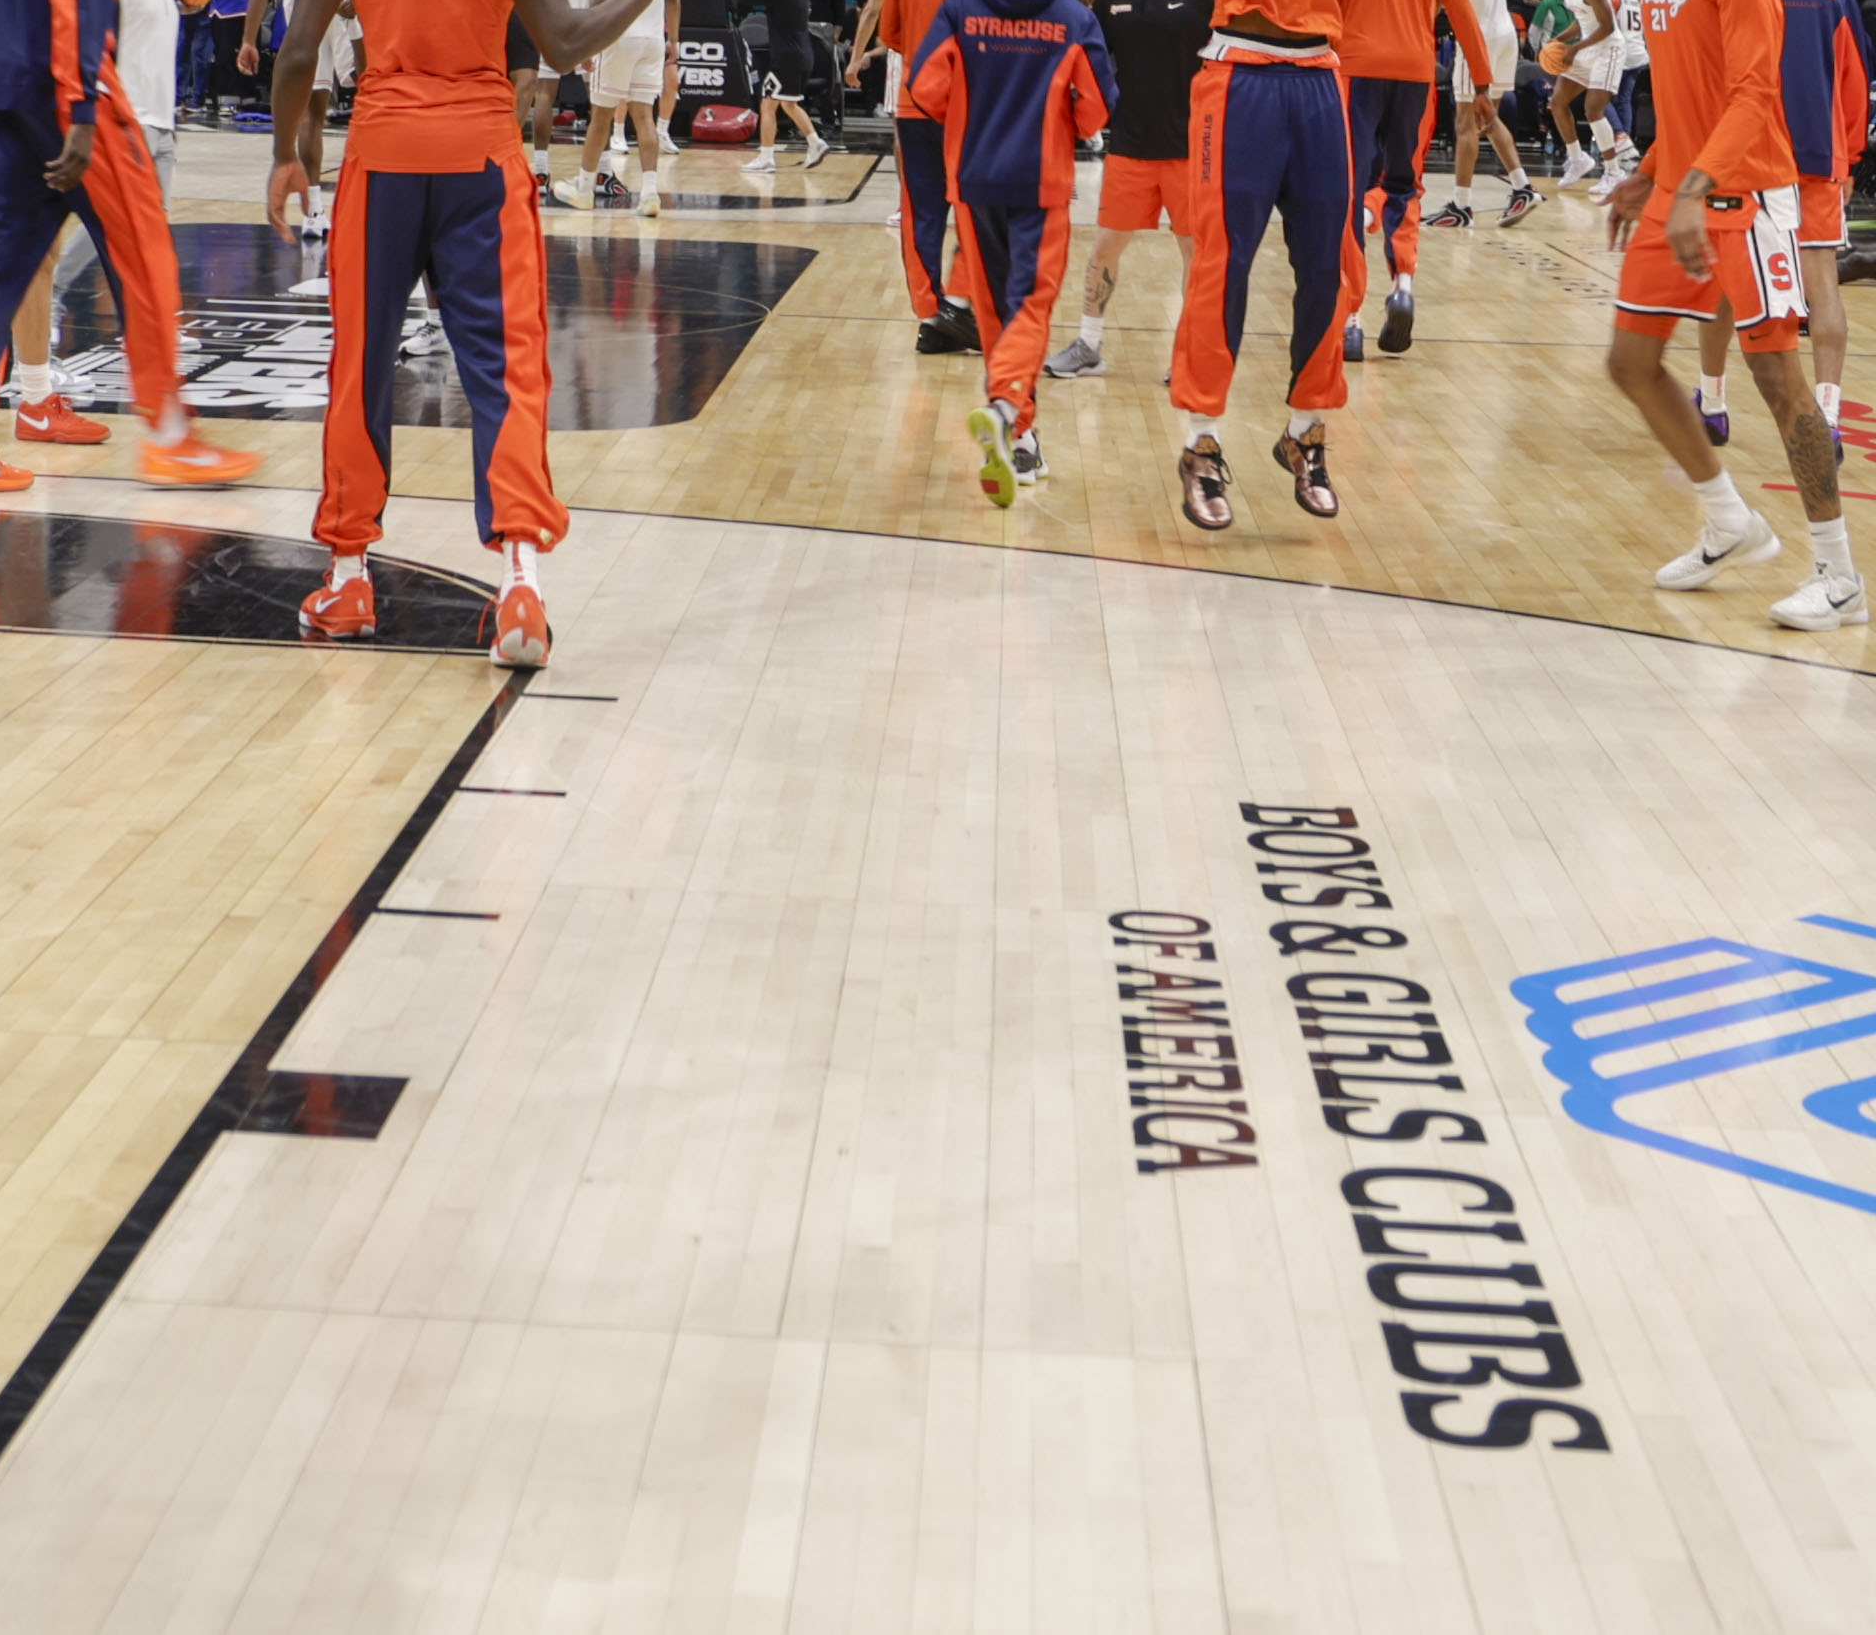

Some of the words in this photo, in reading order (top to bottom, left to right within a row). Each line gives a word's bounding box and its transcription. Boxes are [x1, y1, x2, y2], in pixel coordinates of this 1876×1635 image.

[964, 15, 1068, 45] SYRACUSE
[1627, 10, 1643, 32] 15
[1650, 7, 1668, 32] 21
[1767, 251, 1793, 291] S
[1238, 801, 1394, 910] BOYS
[1107, 909, 1218, 964] OF
[1268, 918, 1409, 957] &
[1115, 964, 1260, 1176] AMERICA
[1285, 970, 1489, 1146] GIRLS
[1339, 1166, 1613, 1454] CLUBS
